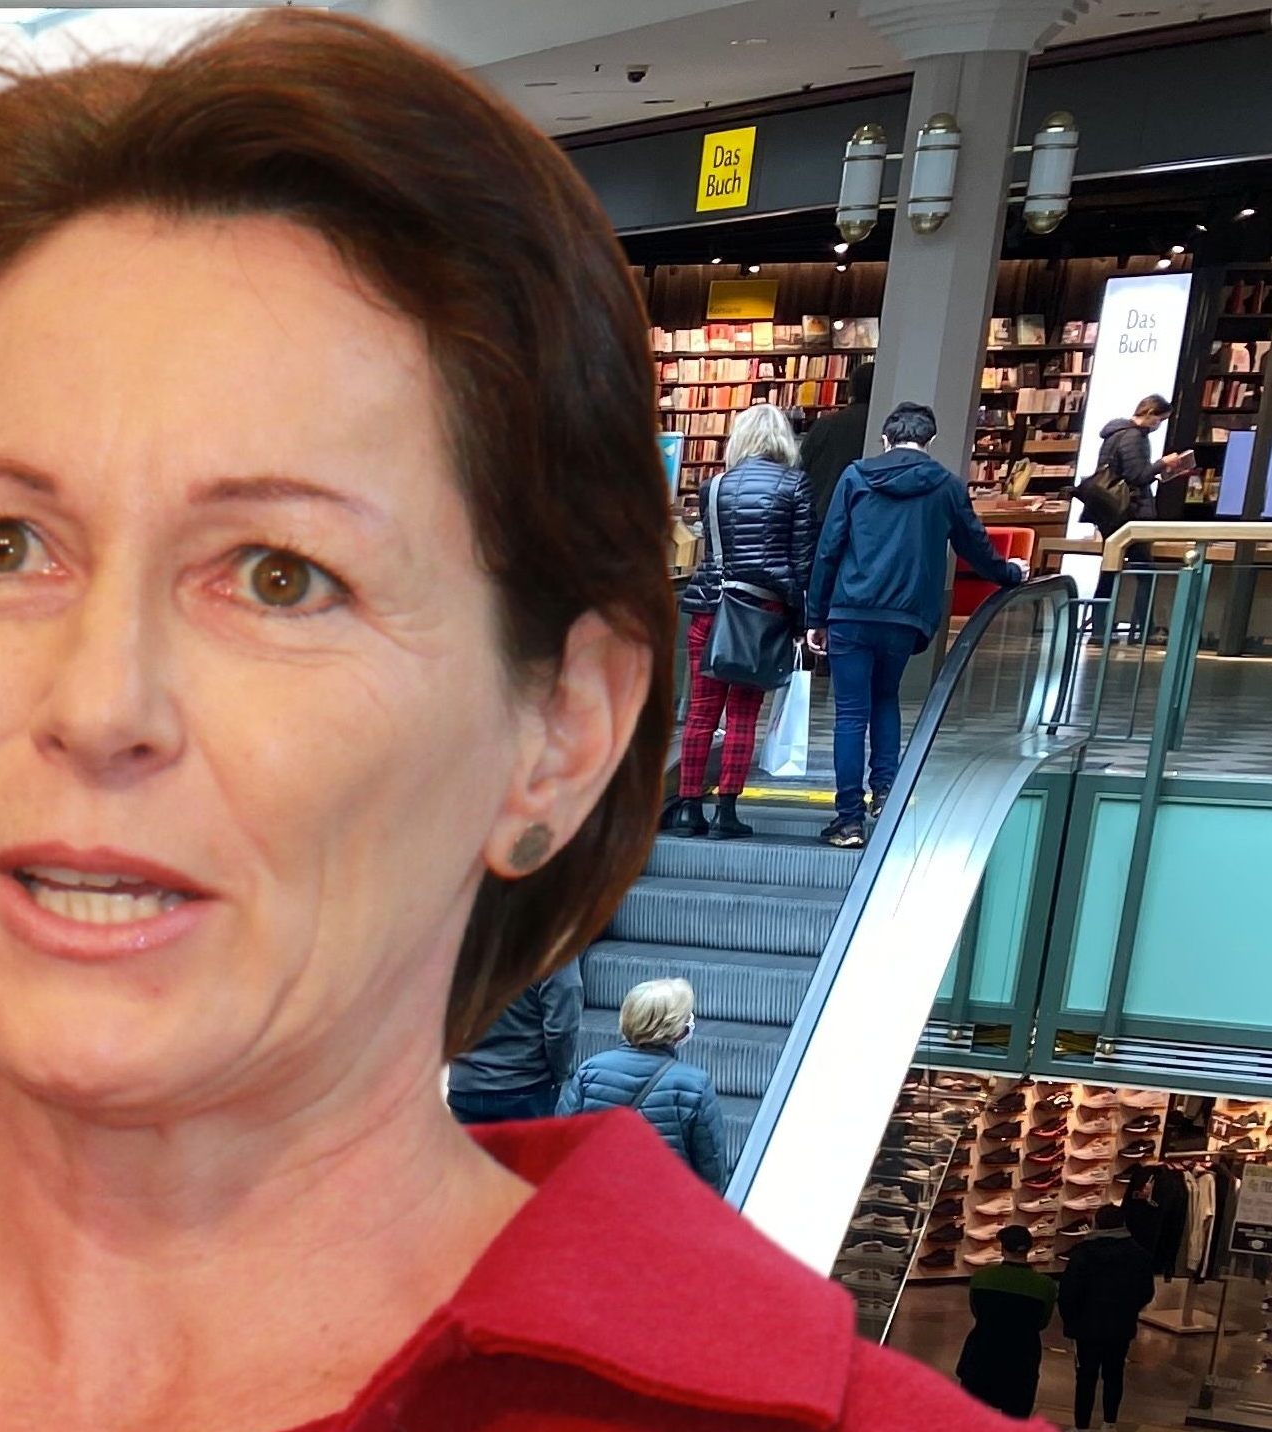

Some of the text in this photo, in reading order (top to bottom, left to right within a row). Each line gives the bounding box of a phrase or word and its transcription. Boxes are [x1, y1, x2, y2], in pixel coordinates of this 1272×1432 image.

[713, 146, 741, 168] Das
[706, 170, 741, 197] Buch
[1127, 309, 1156, 329] Das
[1118, 333, 1158, 354] Buch
